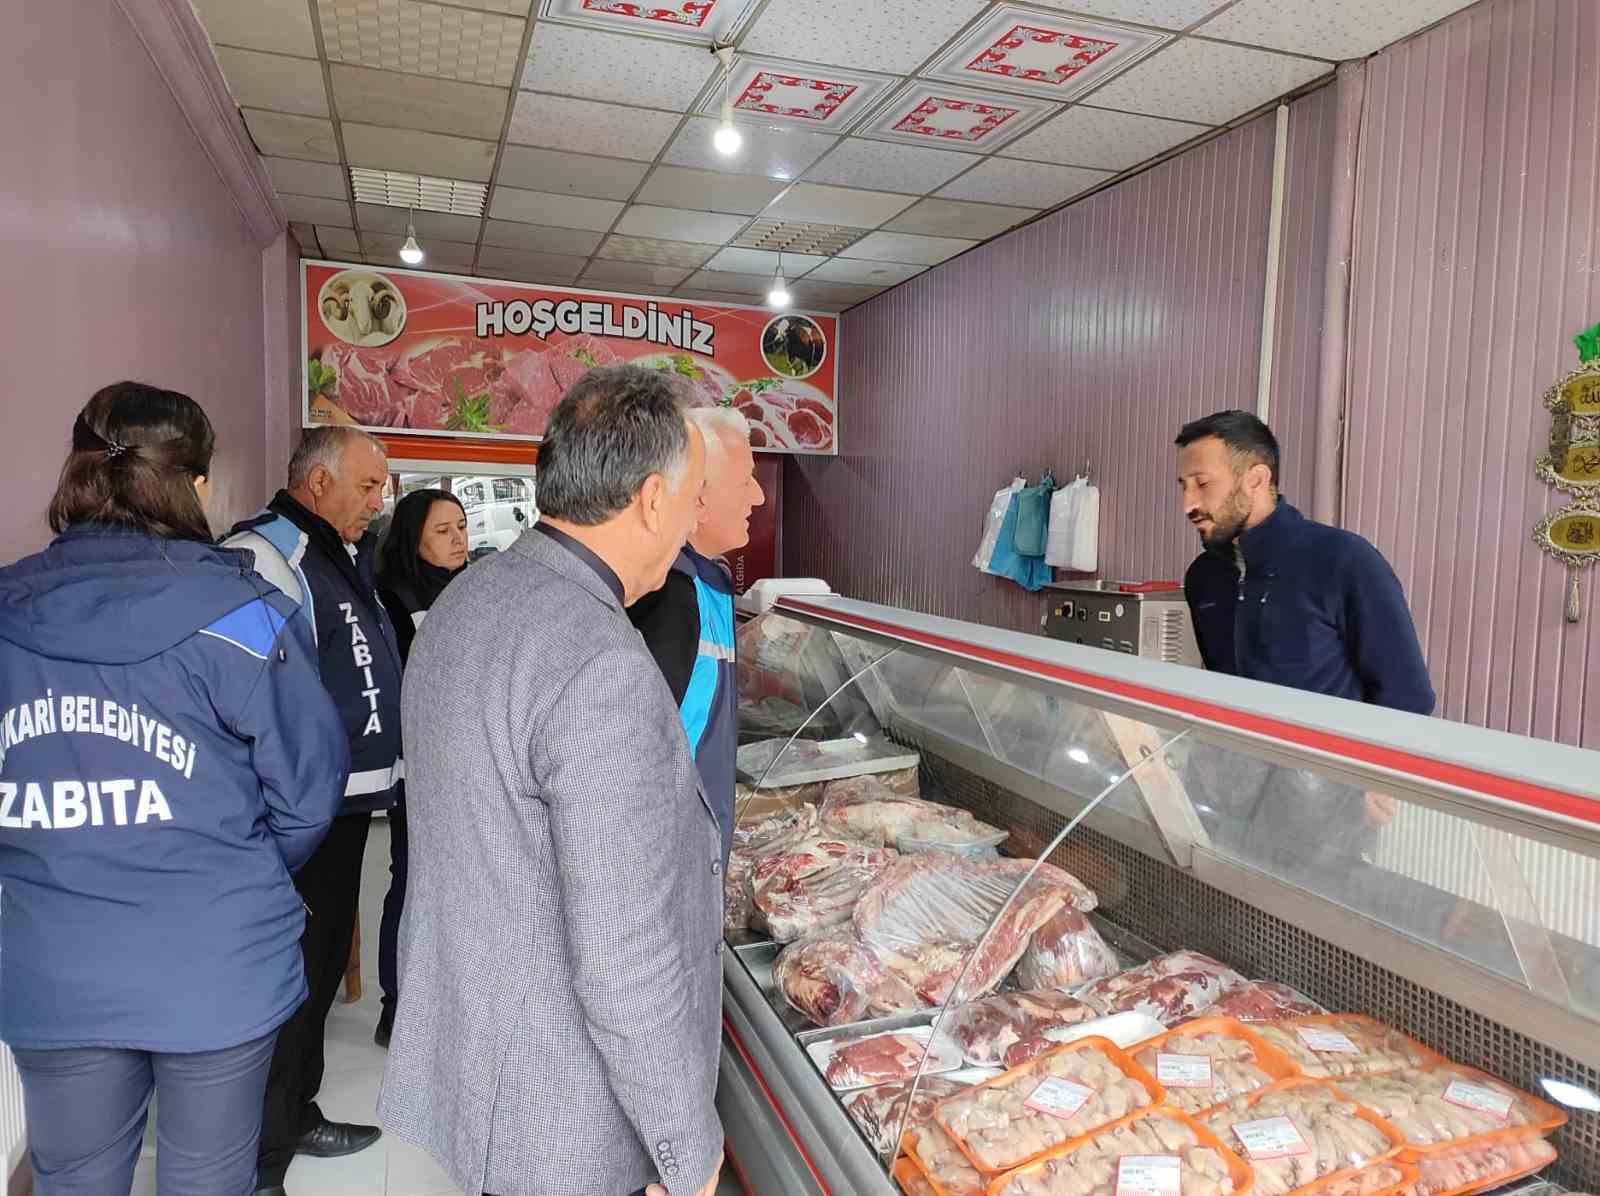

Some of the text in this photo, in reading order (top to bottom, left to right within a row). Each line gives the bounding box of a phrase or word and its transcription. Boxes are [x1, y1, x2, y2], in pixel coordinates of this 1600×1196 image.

[476, 300, 714, 357] HOŞGELDİNİZ
[338, 601, 382, 737] ZABITA
[60, 695, 197, 780] BELEDİYESİ
[0, 779, 174, 829] ZABITA
